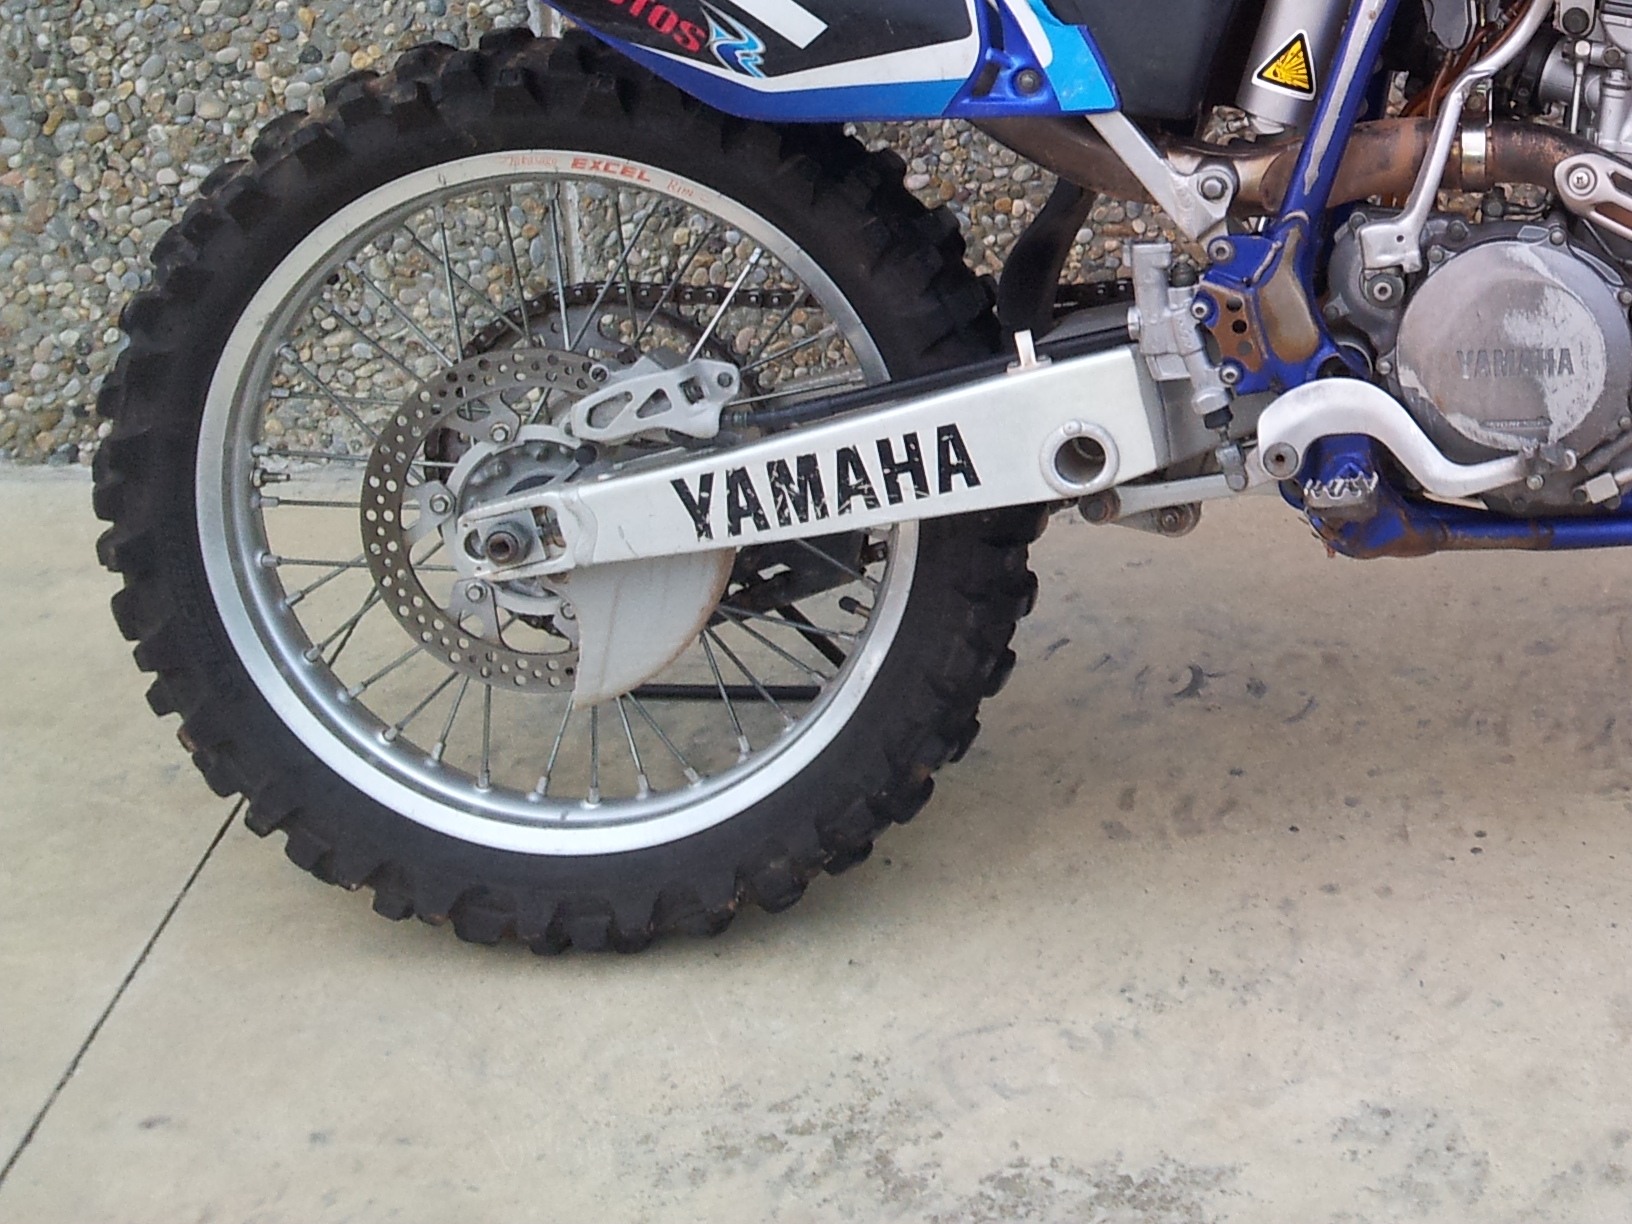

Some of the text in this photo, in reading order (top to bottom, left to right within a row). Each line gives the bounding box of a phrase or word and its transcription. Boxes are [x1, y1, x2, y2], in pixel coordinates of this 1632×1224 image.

[570, 157, 651, 183] EXCEL
[1456, 348, 1575, 379] YAMAHA
[670, 422, 982, 543] YAMAHA
